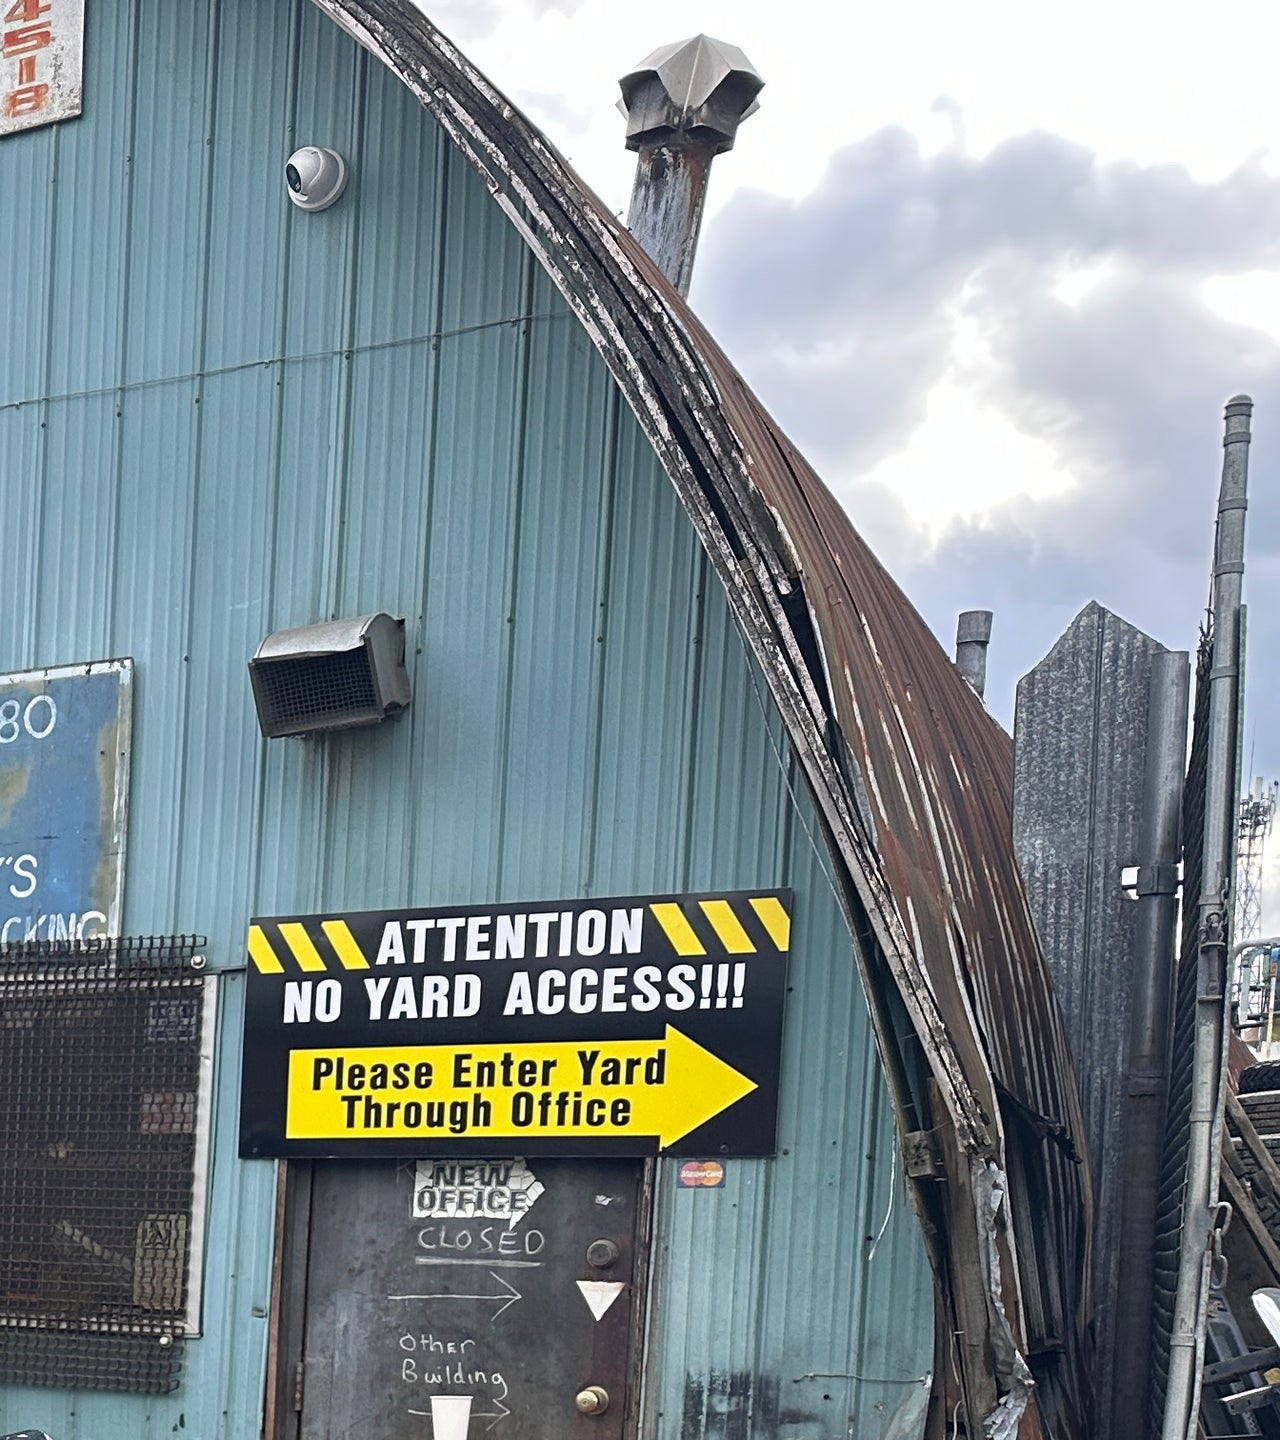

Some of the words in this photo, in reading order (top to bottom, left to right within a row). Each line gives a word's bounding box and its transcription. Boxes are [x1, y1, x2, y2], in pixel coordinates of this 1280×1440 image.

[376, 907, 644, 966] ATTENTION
[283, 980, 342, 1024] NO
[364, 973, 481, 1021] YARD
[503, 963, 746, 1016] ACCESS!!!
[312, 1054, 434, 1091] Please
[452, 1052, 558, 1088] Enter
[578, 1048, 667, 1086] Yard
[341, 1096, 492, 1134] Through
[512, 1092, 632, 1127] Office
[433, 1163, 511, 1187] NEW
[417, 1187, 528, 1211] OFFICE
[417, 1226, 545, 1255] CLOSED
